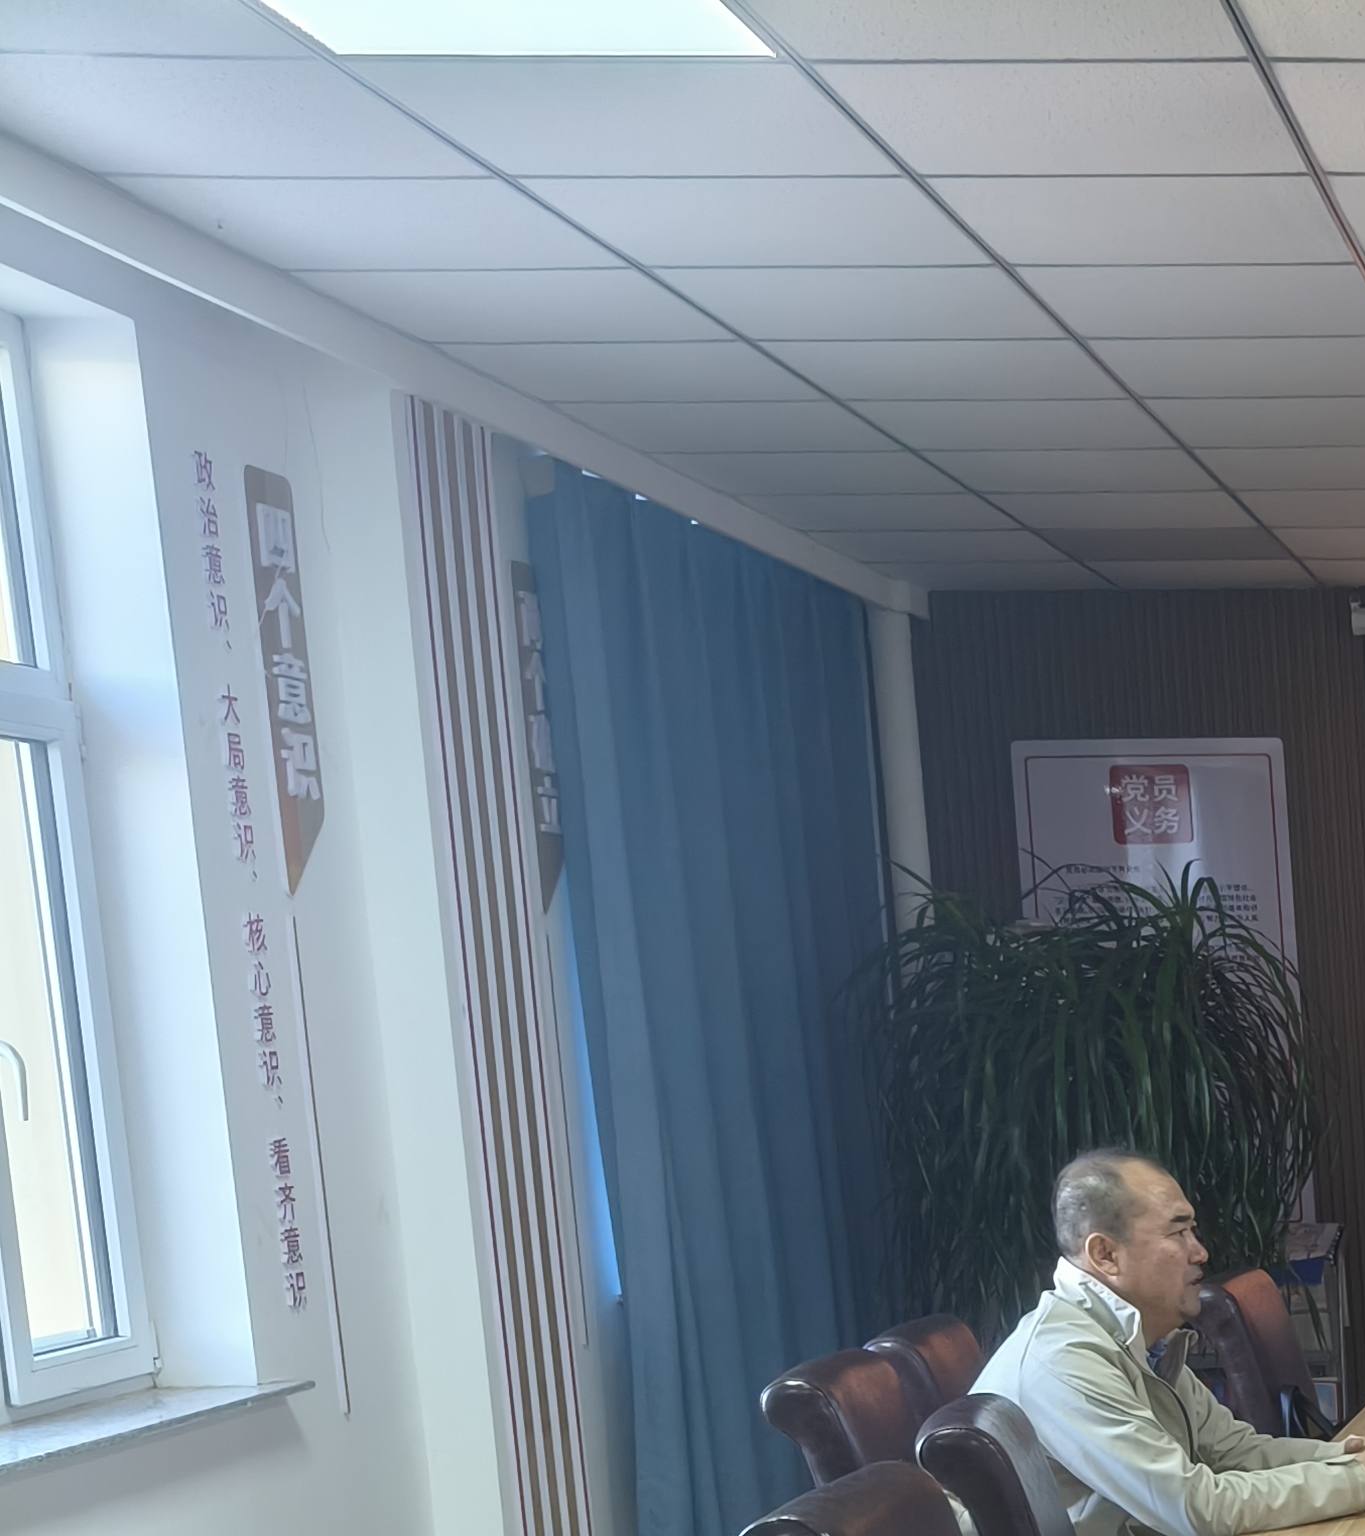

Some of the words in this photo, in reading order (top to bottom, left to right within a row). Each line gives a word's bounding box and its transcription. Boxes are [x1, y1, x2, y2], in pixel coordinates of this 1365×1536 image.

[256, 503, 320, 801] 四个意识
[1121, 774, 1178, 802] 党员
[1124, 806, 1180, 836] 义务
